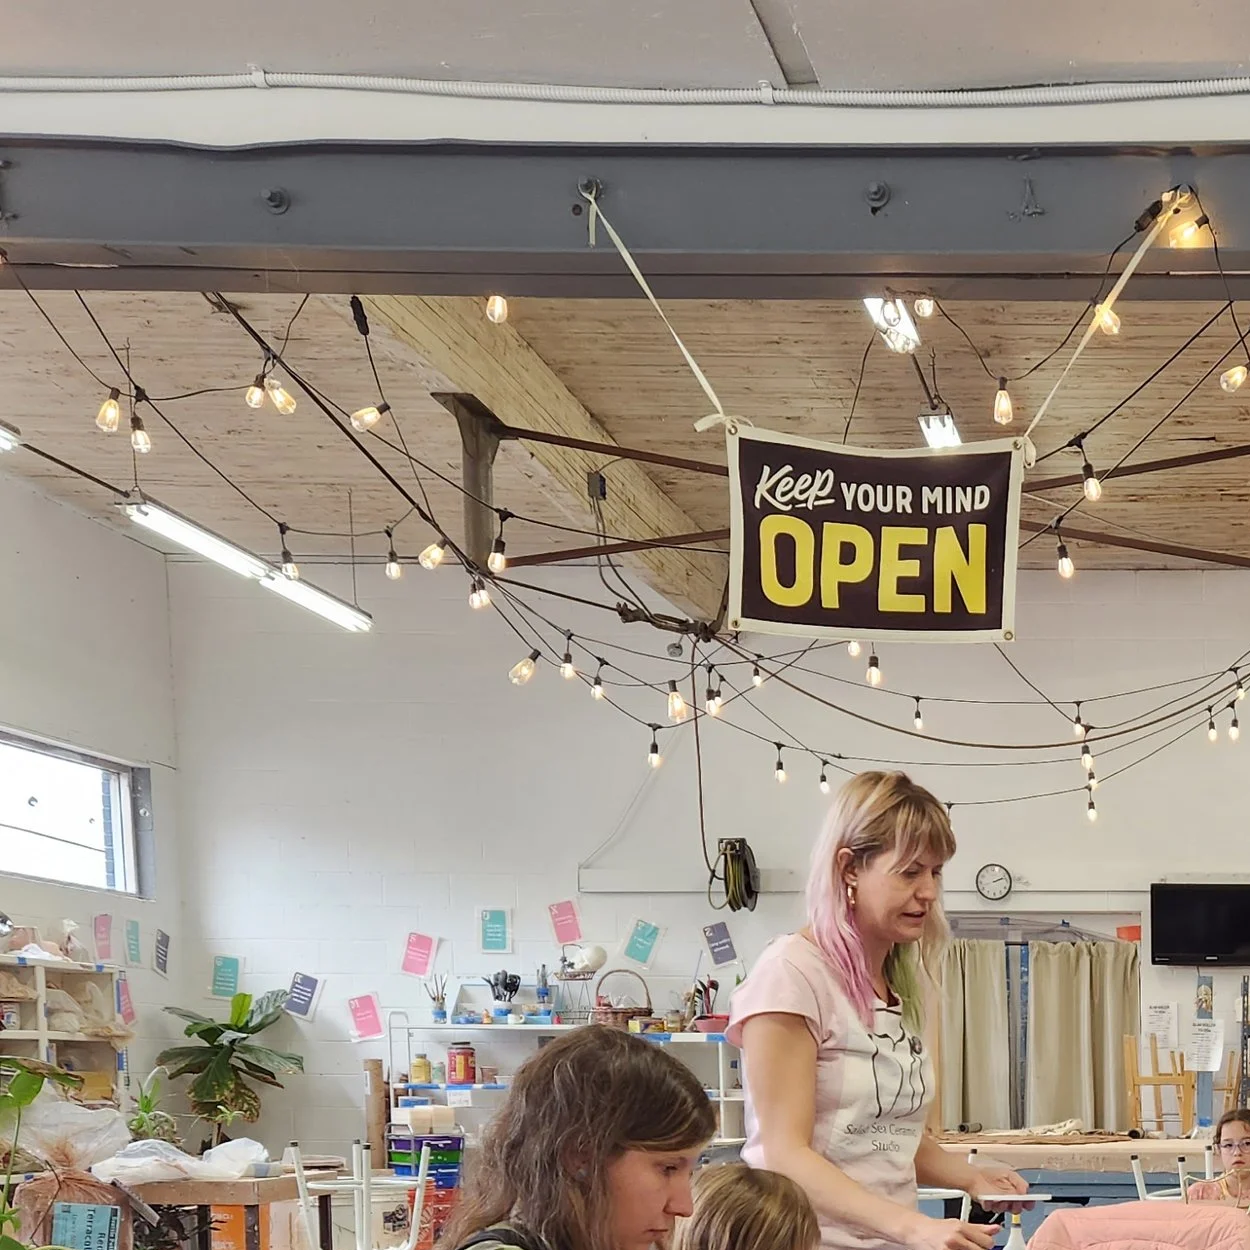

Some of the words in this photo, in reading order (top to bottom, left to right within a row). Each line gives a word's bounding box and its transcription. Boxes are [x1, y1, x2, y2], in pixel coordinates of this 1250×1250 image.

[754, 464, 836, 511] Keep
[841, 482, 913, 514] YOUR
[921, 485, 990, 514] MIND
[759, 514, 987, 615] OPEN
